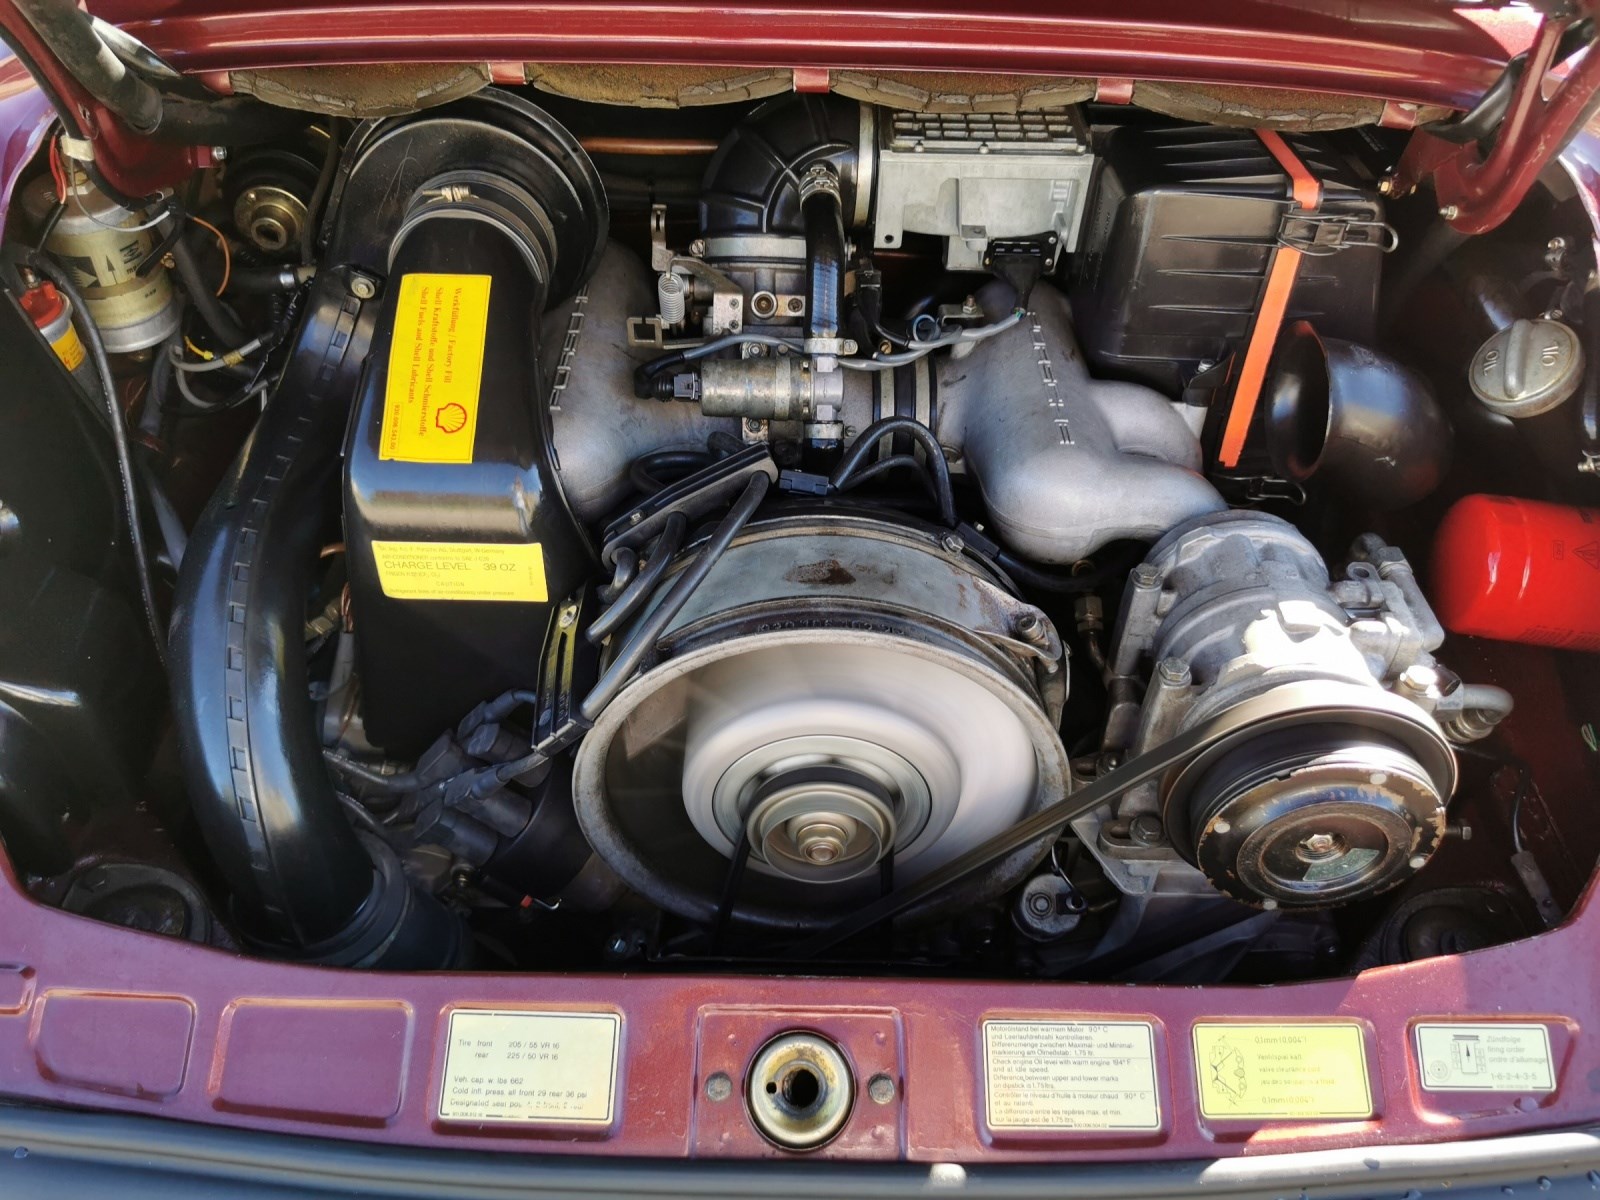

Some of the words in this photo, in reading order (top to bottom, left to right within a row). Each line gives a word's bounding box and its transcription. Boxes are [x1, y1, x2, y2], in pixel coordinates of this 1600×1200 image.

[420, 286, 429, 305] Shell
[434, 287, 444, 305] Shell
[417, 307, 427, 327] Fuels
[448, 288, 462, 332] Werkfüllung
[415, 327, 423, 341] and
[429, 307, 441, 346] Kraftstoffe
[412, 342, 422, 362] Shell
[444, 339, 456, 367] Factory
[425, 363, 434, 383] Shell
[1484, 350, 1498, 377] OIL
[408, 364, 420, 403] Lubricants
[444, 370, 453, 383] Fill
[419, 384, 432, 437] Schmierstoffe
[384, 560, 434, 570] CHARGE
[435, 561, 471, 571] LEVEL
[483, 562, 497, 571] 39
[500, 562, 517, 572] OZ
[459, 1039, 472, 1047] Tire
[508, 1041, 522, 1049] 205
[529, 1041, 538, 1049] 55
[540, 1041, 551, 1049] VR
[506, 1051, 521, 1059] 225
[527, 1052, 537, 1060] 50
[539, 1052, 550, 1060] VR
[510, 1077, 524, 1085] 662
[452, 1087, 469, 1095] Cold
[519, 1089, 535, 1097] front
[577, 1091, 588, 1099] psi
